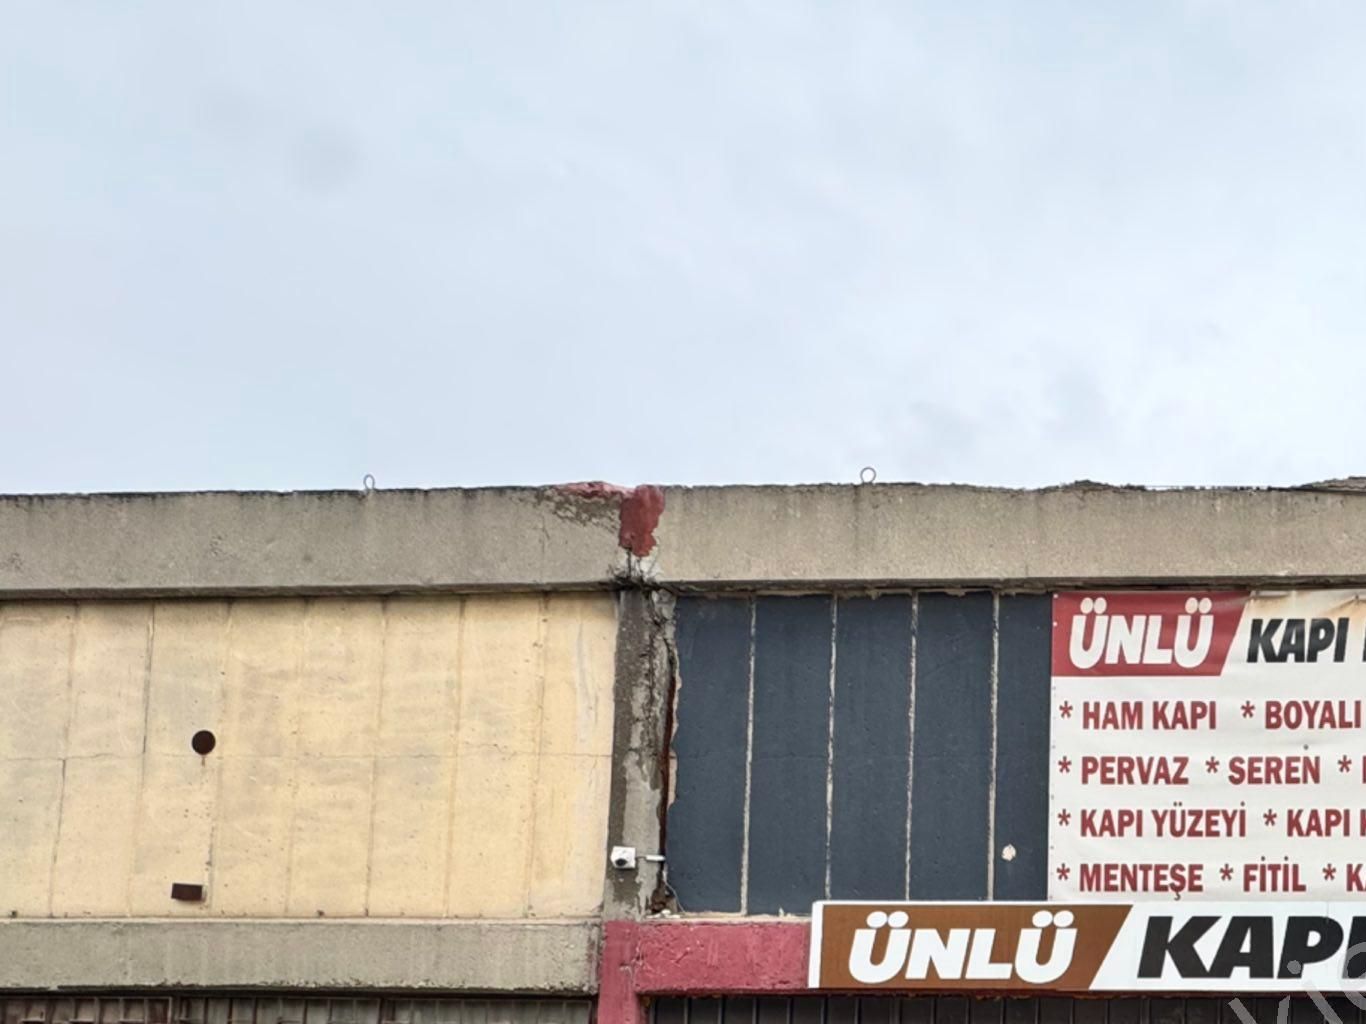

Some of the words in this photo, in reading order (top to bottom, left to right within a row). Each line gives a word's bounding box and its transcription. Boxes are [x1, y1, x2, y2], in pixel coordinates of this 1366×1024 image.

[1069, 597, 1214, 669] ÜNLÜ
[1246, 617, 1349, 663] KAPI
[1082, 702, 1144, 730] HAM
[1151, 701, 1217, 730] KAPI
[1264, 700, 1362, 730] BOYALI
[1080, 755, 1189, 786] PERVAZ
[1228, 755, 1321, 785] SEREN
[1080, 809, 1143, 837] KAPI
[1151, 802, 1247, 838] YÜZEYİ
[1286, 809, 1351, 837] KAPI
[1078, 863, 1204, 900] MENTEŞE
[1242, 856, 1306, 892] FİTİL
[848, 911, 1078, 984] ÜNLÜ
